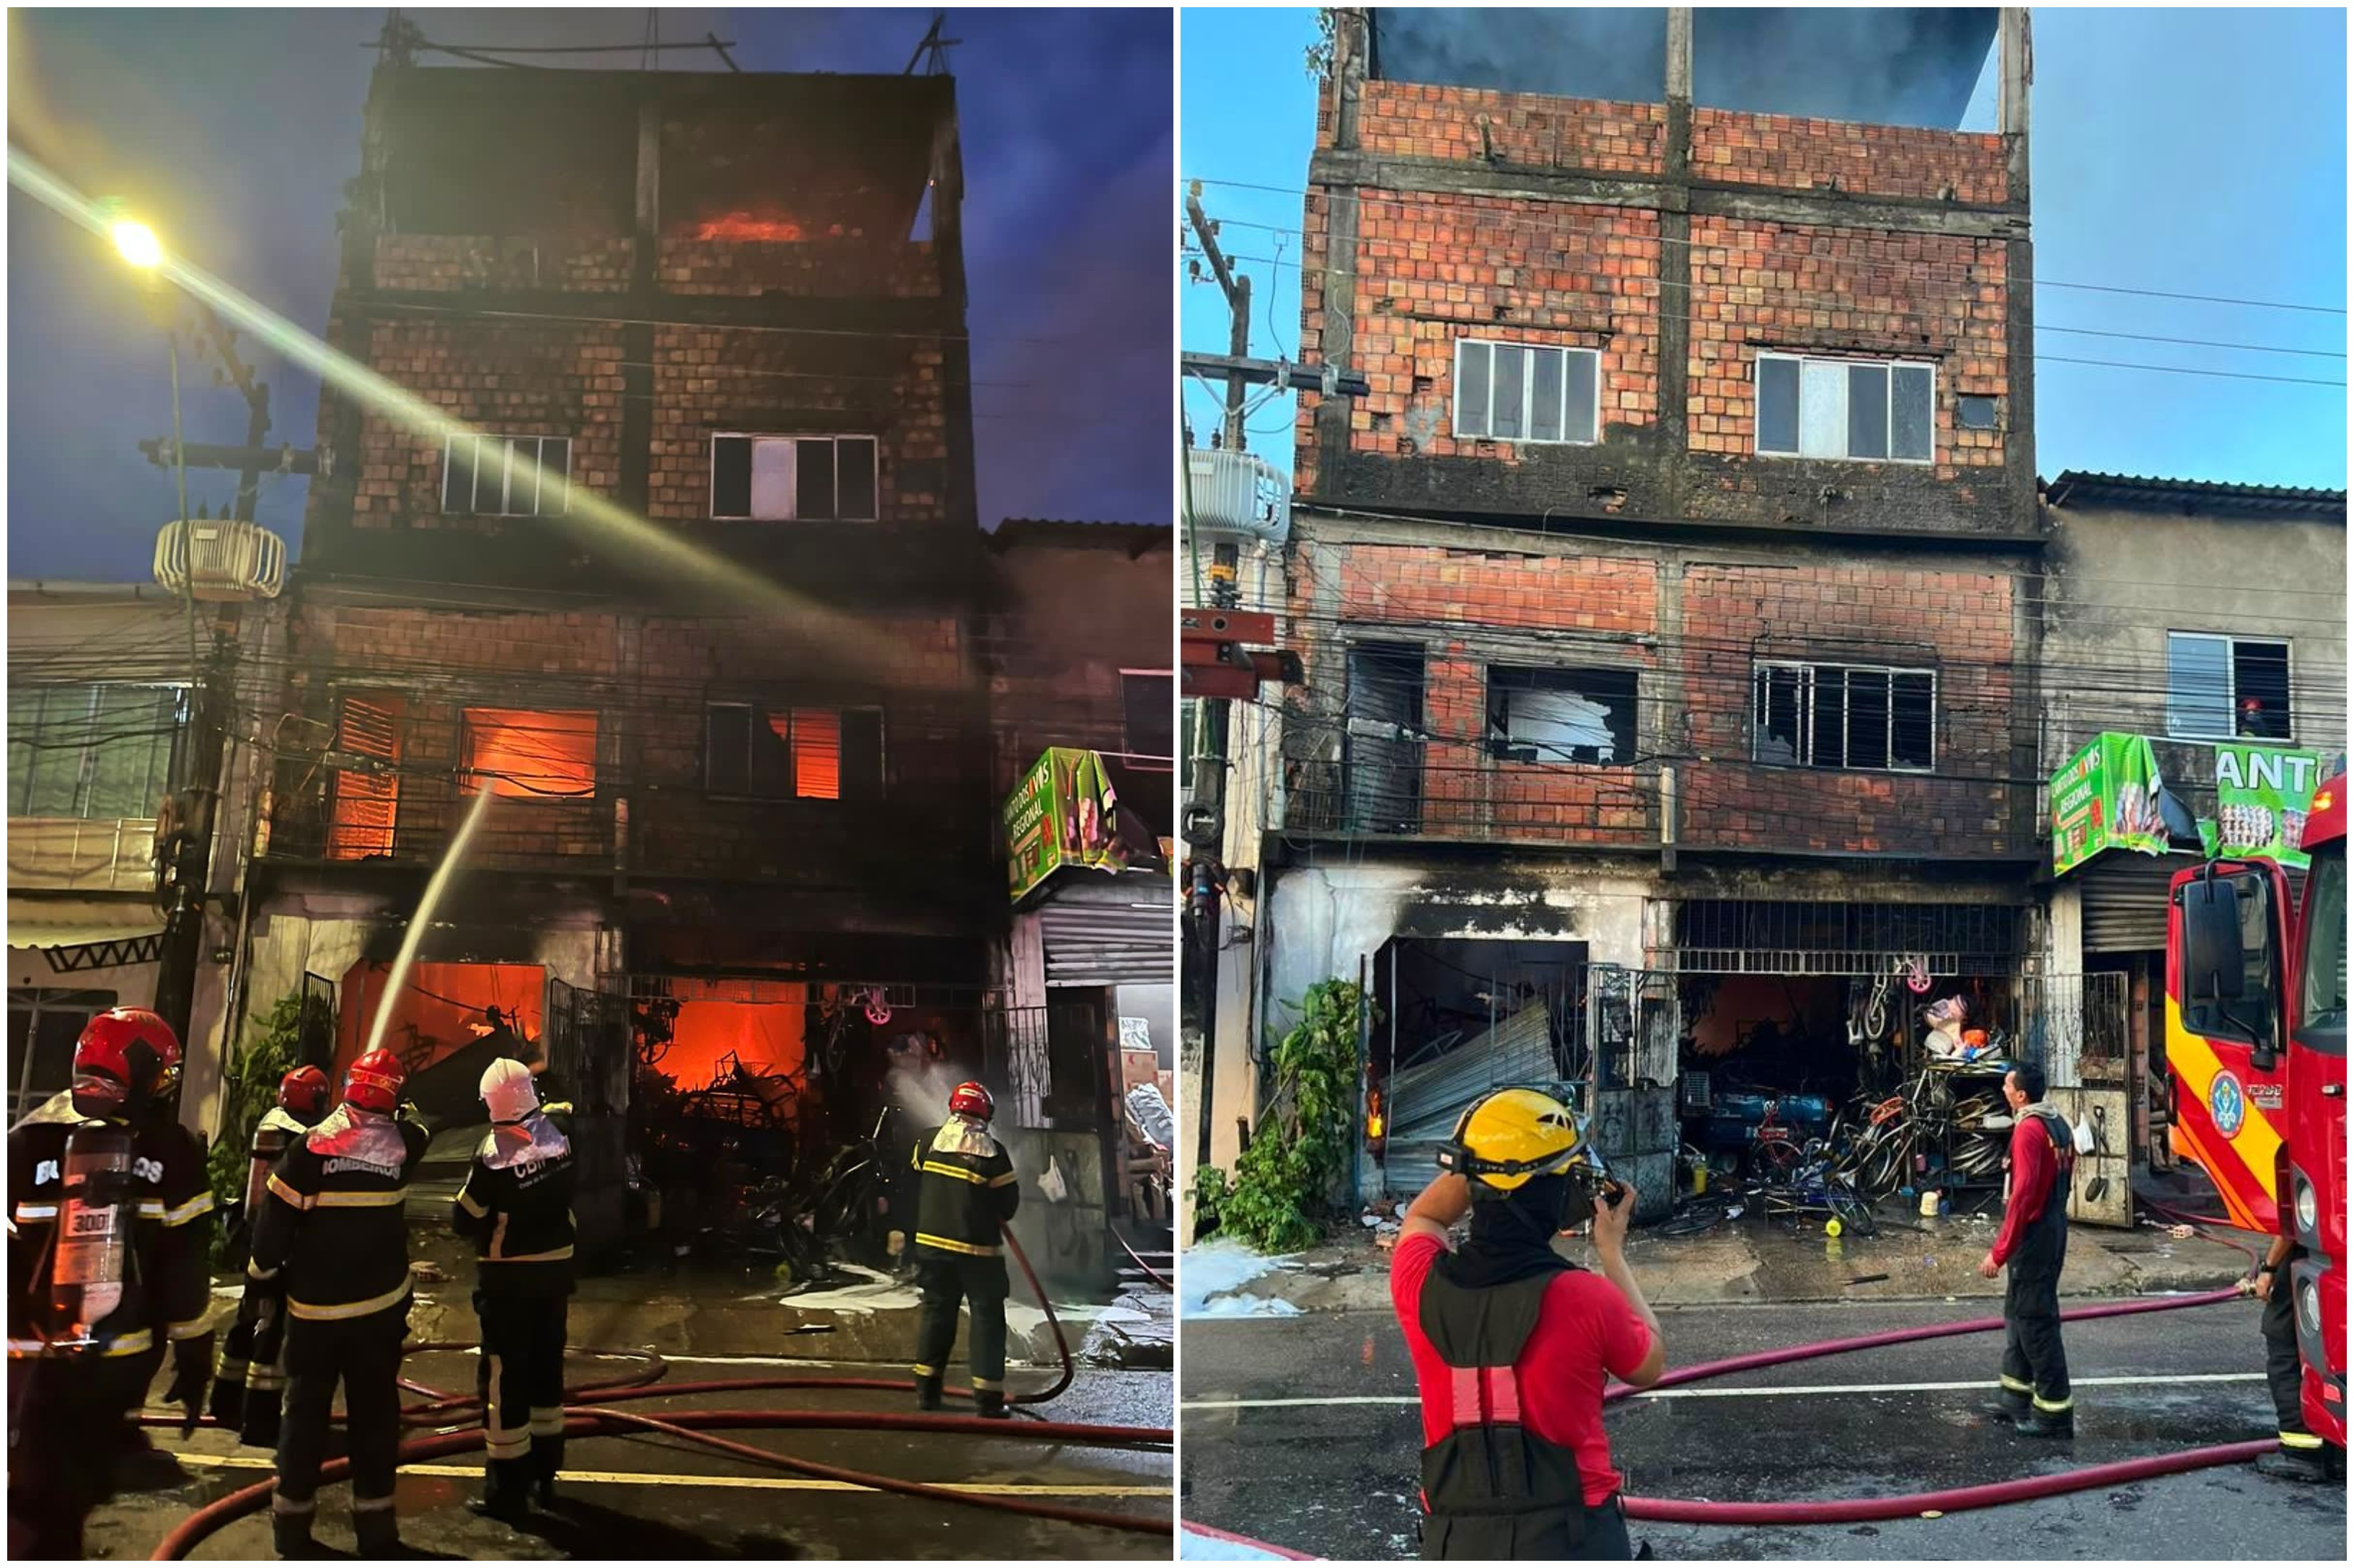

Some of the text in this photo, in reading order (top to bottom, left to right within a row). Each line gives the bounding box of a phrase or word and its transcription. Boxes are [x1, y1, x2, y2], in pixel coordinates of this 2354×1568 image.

[2216, 751, 2321, 793] ANT
[2060, 779, 2093, 814] REGIONAL
[1013, 798, 1044, 841] REGIONAL
